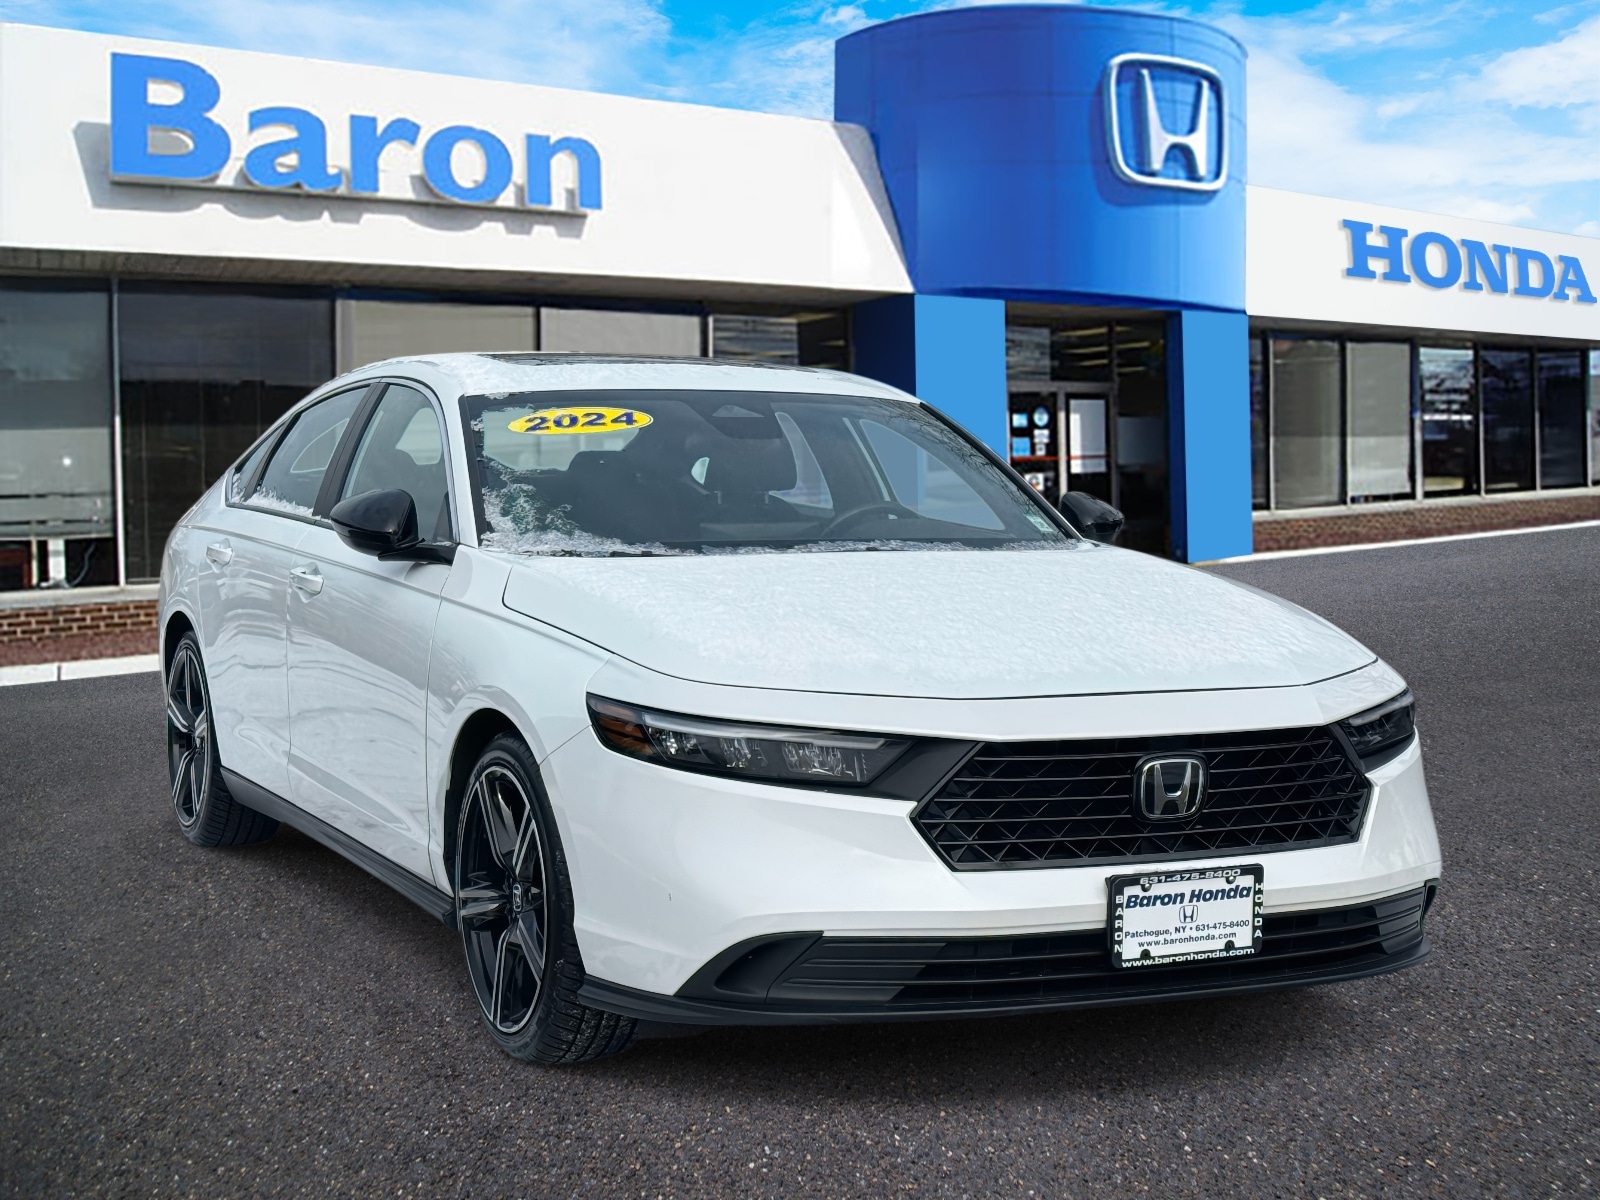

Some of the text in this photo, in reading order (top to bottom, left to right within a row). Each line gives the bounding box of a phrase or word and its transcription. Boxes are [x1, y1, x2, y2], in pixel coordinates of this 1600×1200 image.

[110, 52, 602, 211] Baron
[1343, 219, 1597, 304] HONDA
[524, 411, 639, 433] 2024
[1140, 868, 1241, 885] 631-475-8400
[1125, 885, 1252, 909] Baron Honda
[1254, 883, 1264, 938] HONDA
[1114, 895, 1124, 953] BARON
[1124, 919, 1250, 940] Patchogue, NY 631-475-8400
[1137, 930, 1237, 948] www.baronhonda.com
[1121, 947, 1255, 968] www.baronhonda.com
